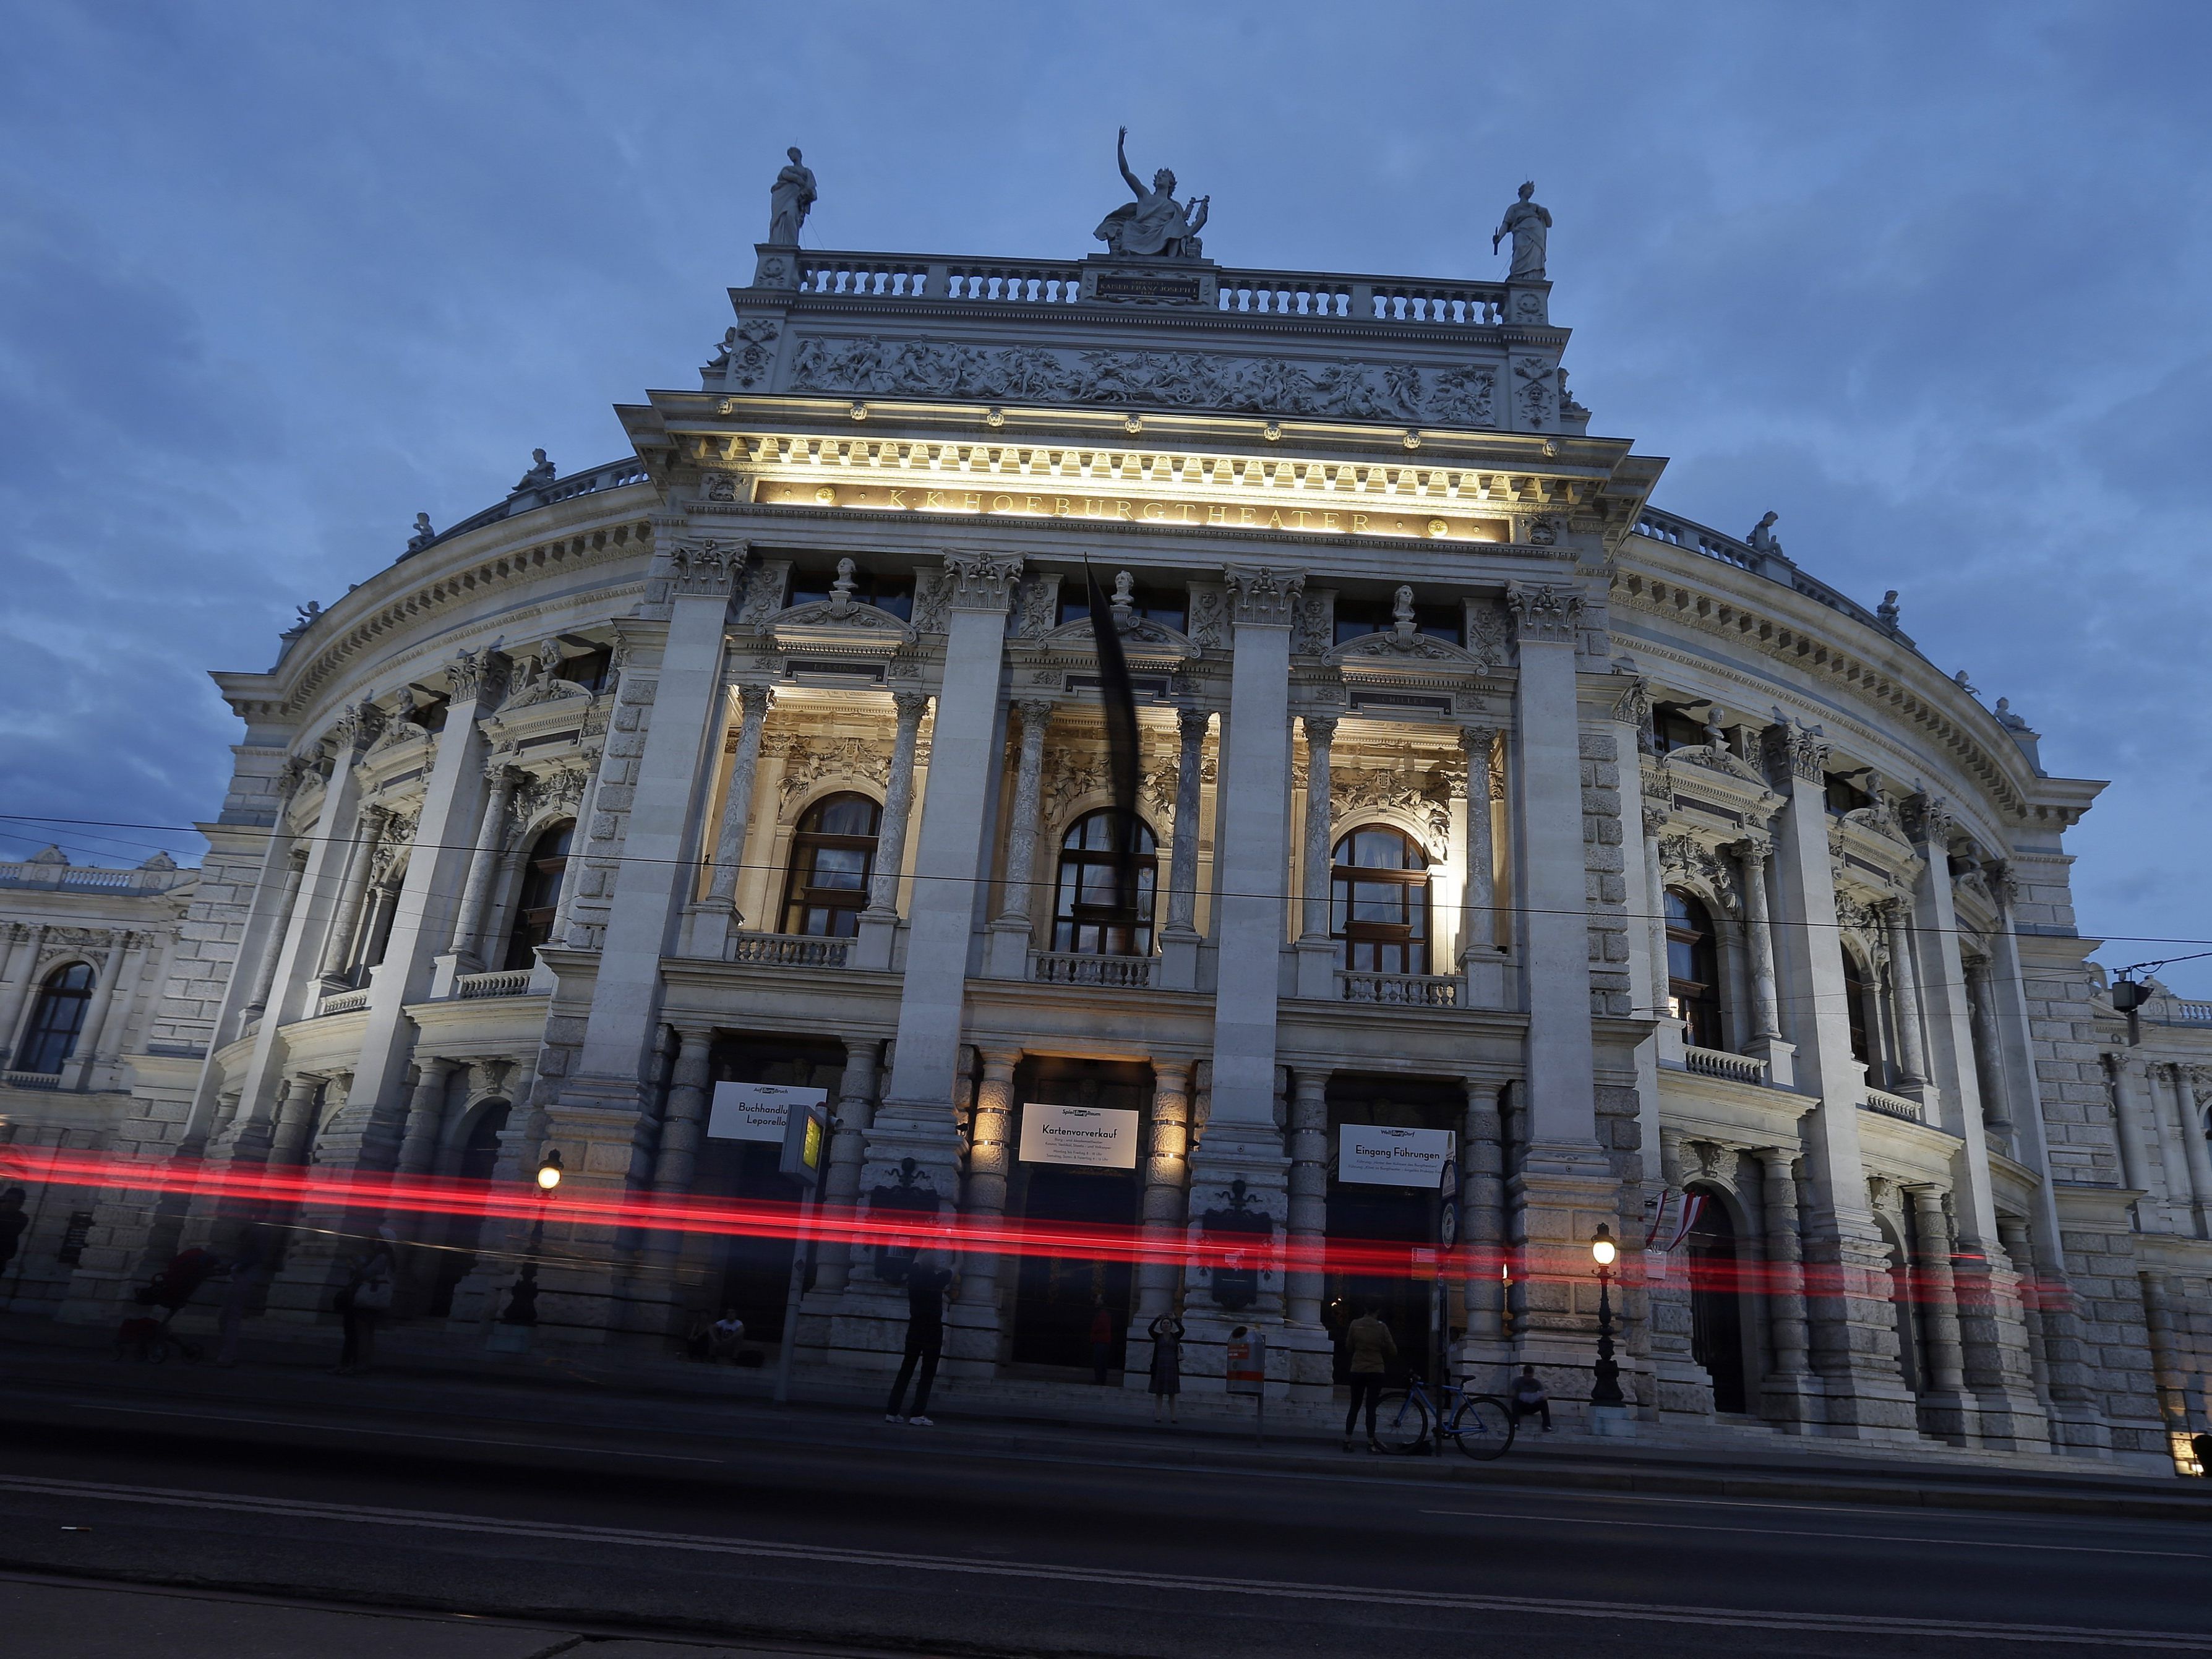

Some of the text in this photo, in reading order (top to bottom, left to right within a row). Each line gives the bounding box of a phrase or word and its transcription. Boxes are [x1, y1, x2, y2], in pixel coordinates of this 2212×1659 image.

[739, 1102, 787, 1114] Buchhandlu
[747, 1114, 787, 1126] Leporello
[1042, 1125, 1118, 1138] Kartenvorverkauf
[1356, 1145, 1391, 1159] Eingang
[1394, 1147, 1440, 1160] Führungen
